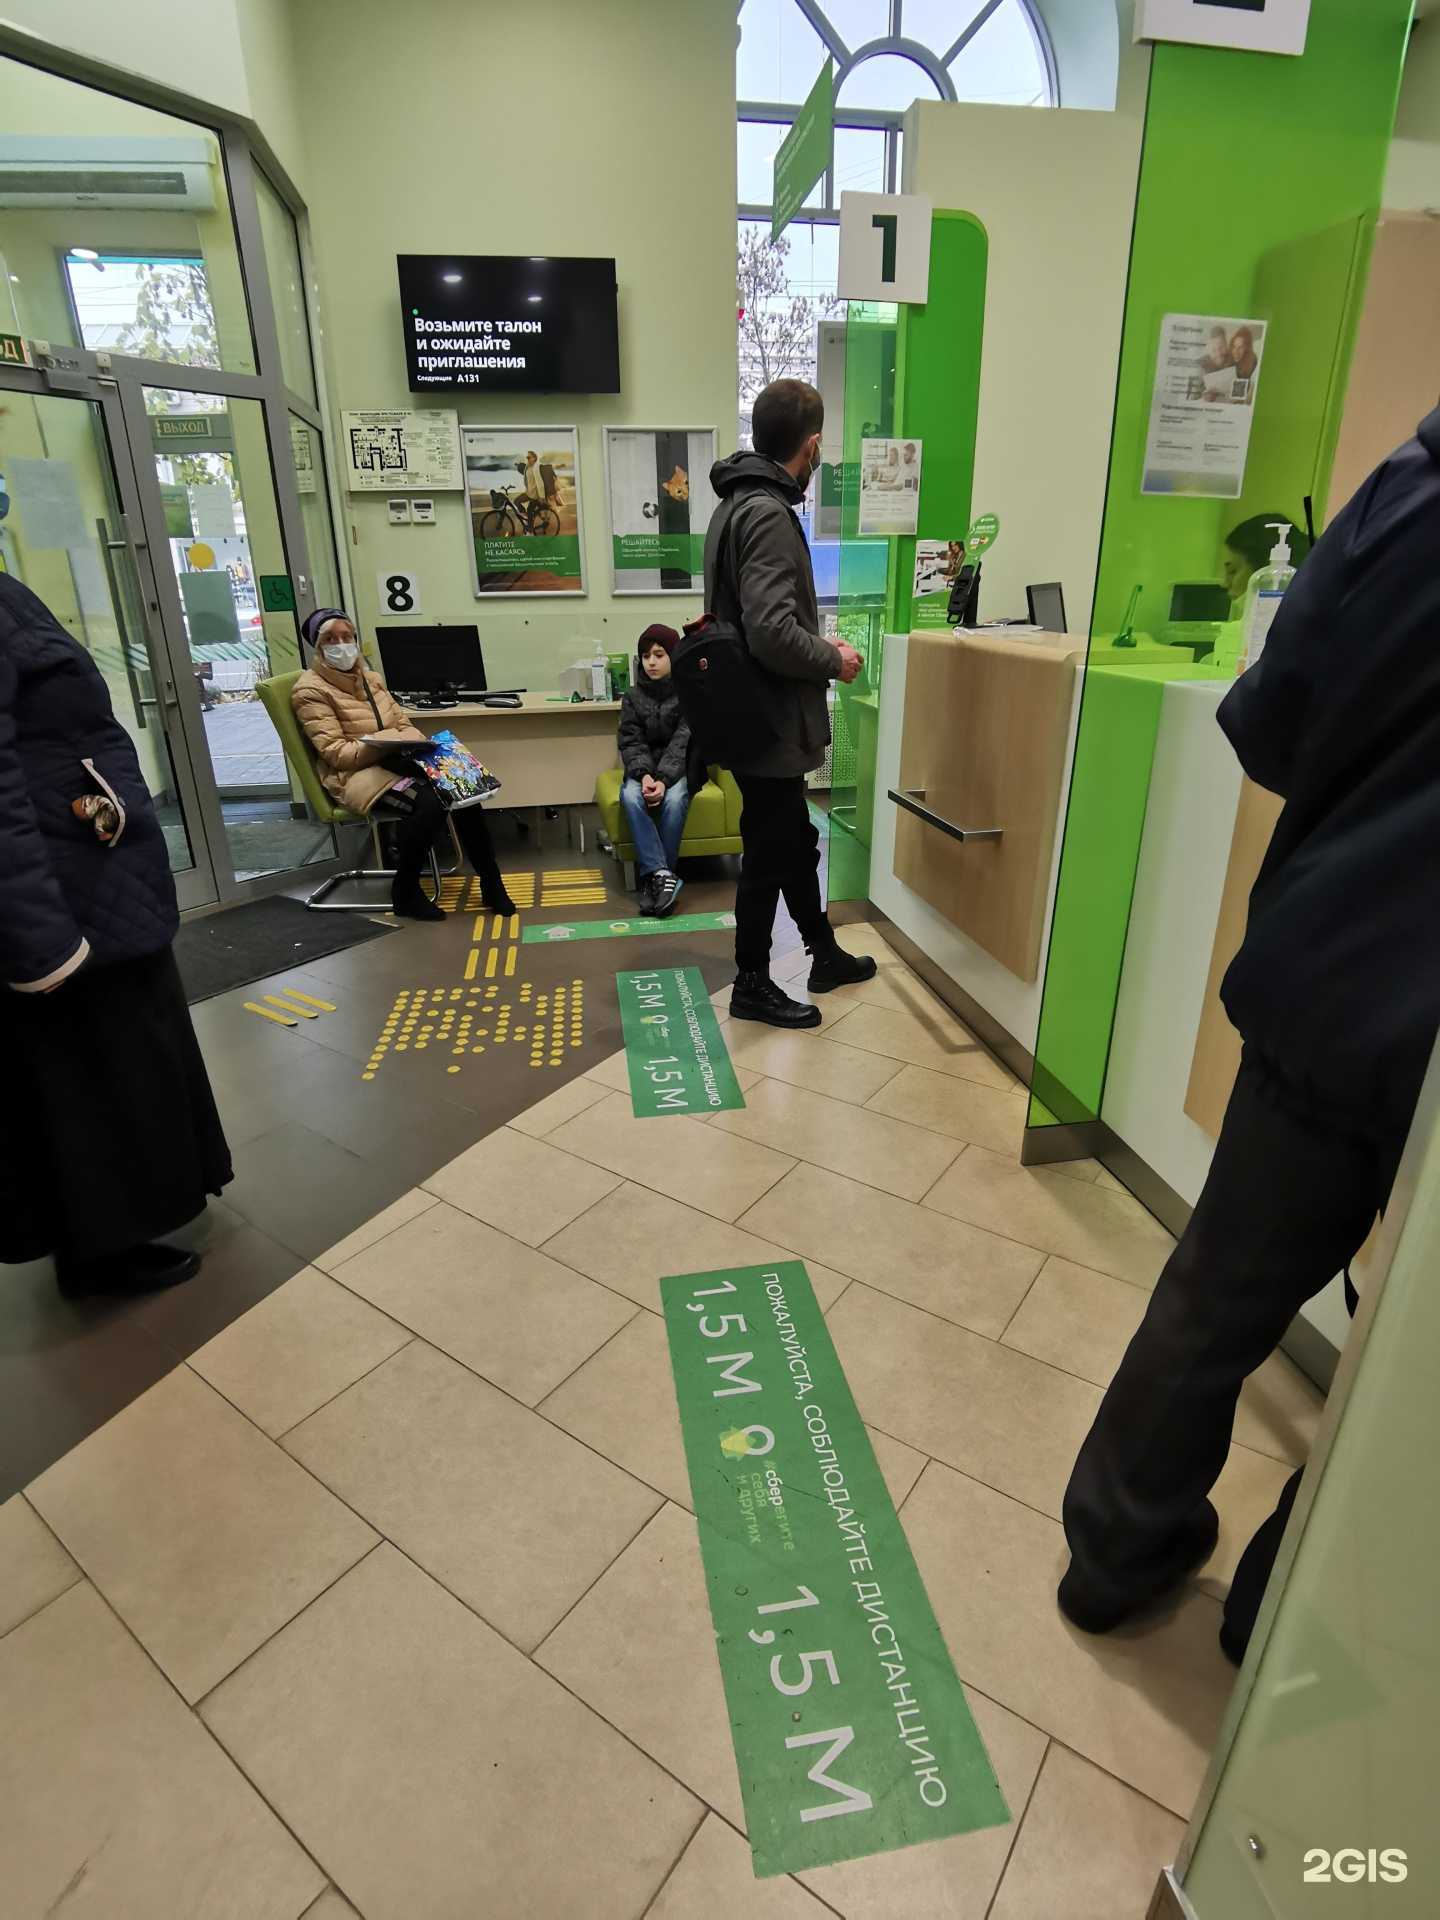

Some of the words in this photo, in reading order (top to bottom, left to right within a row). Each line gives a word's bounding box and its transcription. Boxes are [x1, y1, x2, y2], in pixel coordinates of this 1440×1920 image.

[872, 214, 897, 282] 1
[414, 318, 493, 333] Возьмите
[495, 320, 542, 333] талон
[416, 338, 427, 350] и
[430, 335, 511, 353] ожидайте
[418, 356, 526, 372] приглашения
[457, 374, 480, 383] А131
[162, 421, 205, 434] ВЫХОД
[484, 541, 515, 549] ПЛАТИТЕ
[495, 548, 526, 556] КАСАЯСЬ
[386, 575, 414, 612] 8
[629, 972, 662, 991] 1,5
[637, 994, 666, 1009] М
[684, 1008, 707, 1056] СОБЛЮДАЙТЕ
[642, 1055, 683, 1082] 1,5
[695, 1053, 722, 1106] ДИСТАНЦИЮ
[654, 1087, 689, 1109] М
[686, 1280, 748, 1339] 1,5
[706, 1351, 763, 1398] М
[751, 1472, 768, 1508] себя
[763, 1460, 795, 1552] #сберегите
[737, 1487, 762, 1544] других
[761, 1272, 815, 1400] ПОЖАЛУЙСТА,
[803, 1404, 874, 1574] СОБЛЮДАЙТЕ
[851, 1581, 948, 1808] ДИСТАНЦИЮ
[747, 1585, 841, 1696] 1,5
[785, 1725, 874, 1824] М
